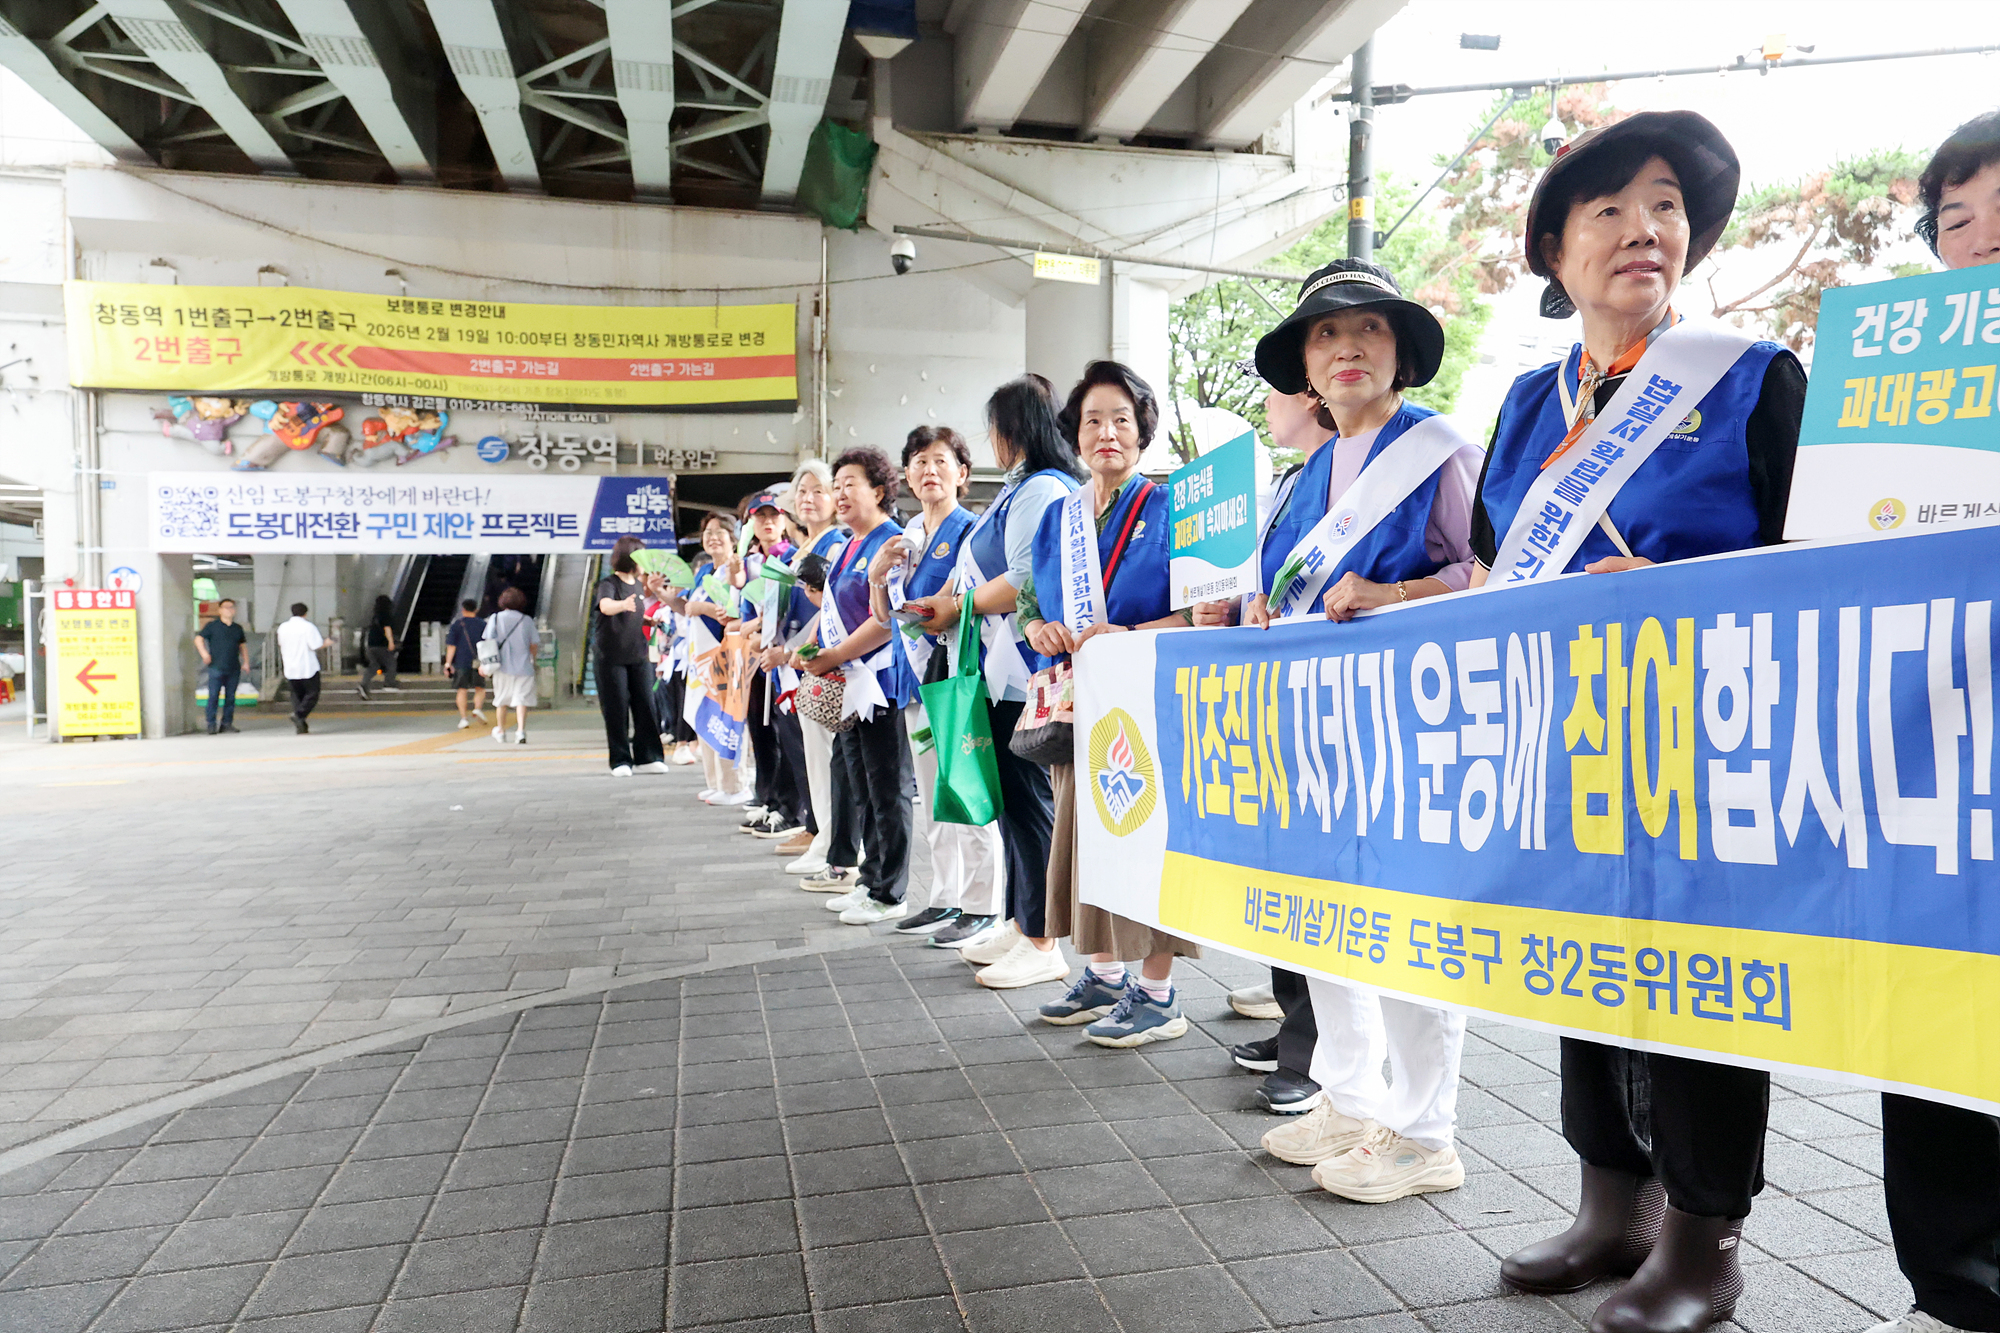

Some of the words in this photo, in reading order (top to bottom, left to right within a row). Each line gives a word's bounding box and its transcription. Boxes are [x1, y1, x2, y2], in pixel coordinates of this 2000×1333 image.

[1321, 273, 1348, 285] CLOUD
[1350, 272, 1366, 280] HAS
[95, 303, 162, 327] 창동역
[175, 307, 254, 329] 1번출구
[279, 309, 357, 332] 2번출구
[387, 298, 444, 316] 보행통로
[450, 303, 506, 319] 변경안내
[366, 323, 420, 341] 2026년
[427, 327, 450, 342] 2월
[457, 329, 489, 344] 19일
[497, 331, 567, 347] 10:00부터
[574, 332, 659, 348] 창동민자역사
[665, 332, 733, 348] 개방통로로
[739, 331, 765, 347] 변경
[1852, 298, 1928, 358] 건강
[134, 336, 242, 365] 2번출구
[470, 359, 517, 374] 2번출구
[522, 361, 559, 375] 가는길
[267, 370, 317, 383] 개방통로
[629, 362, 674, 377] 2번출구
[678, 362, 715, 376] 가는길
[1608, 374, 1683, 443] 법질서
[1837, 364, 2000, 428] 과대광고
[518, 432, 617, 472] 창동역
[1173, 478, 1187, 512] 건강
[1187, 464, 1214, 505] 기능식품
[1553, 439, 1626, 507] 확립을
[226, 485, 265, 506] 신임
[271, 485, 417, 506] 도봉구청장에게
[422, 486, 492, 507] 바란다!
[627, 494, 673, 515] 민주
[227, 512, 360, 540] 도봉대전환
[366, 512, 418, 540] 구민
[423, 512, 474, 540] 제안
[480, 512, 580, 540] 프로젝트
[1069, 499, 1085, 538] 법질서
[1174, 510, 1205, 550] 과대광고에
[1206, 493, 1247, 537] 속지마세요!
[1528, 501, 1574, 555] 위한
[1070, 536, 1088, 574] 확립을
[1507, 547, 1545, 582] 기
[1072, 572, 1091, 600] 위한
[1175, 661, 1289, 829] 기초질서
[1288, 649, 1405, 840] 지키기
[1410, 631, 1553, 852] 운동에
[1563, 598, 1994, 875] 참여합시다!
[1244, 886, 1391, 961] 바르게살기운동
[1409, 918, 1502, 985] 도봉구
[1520, 933, 1792, 1031] 창2동위원회
